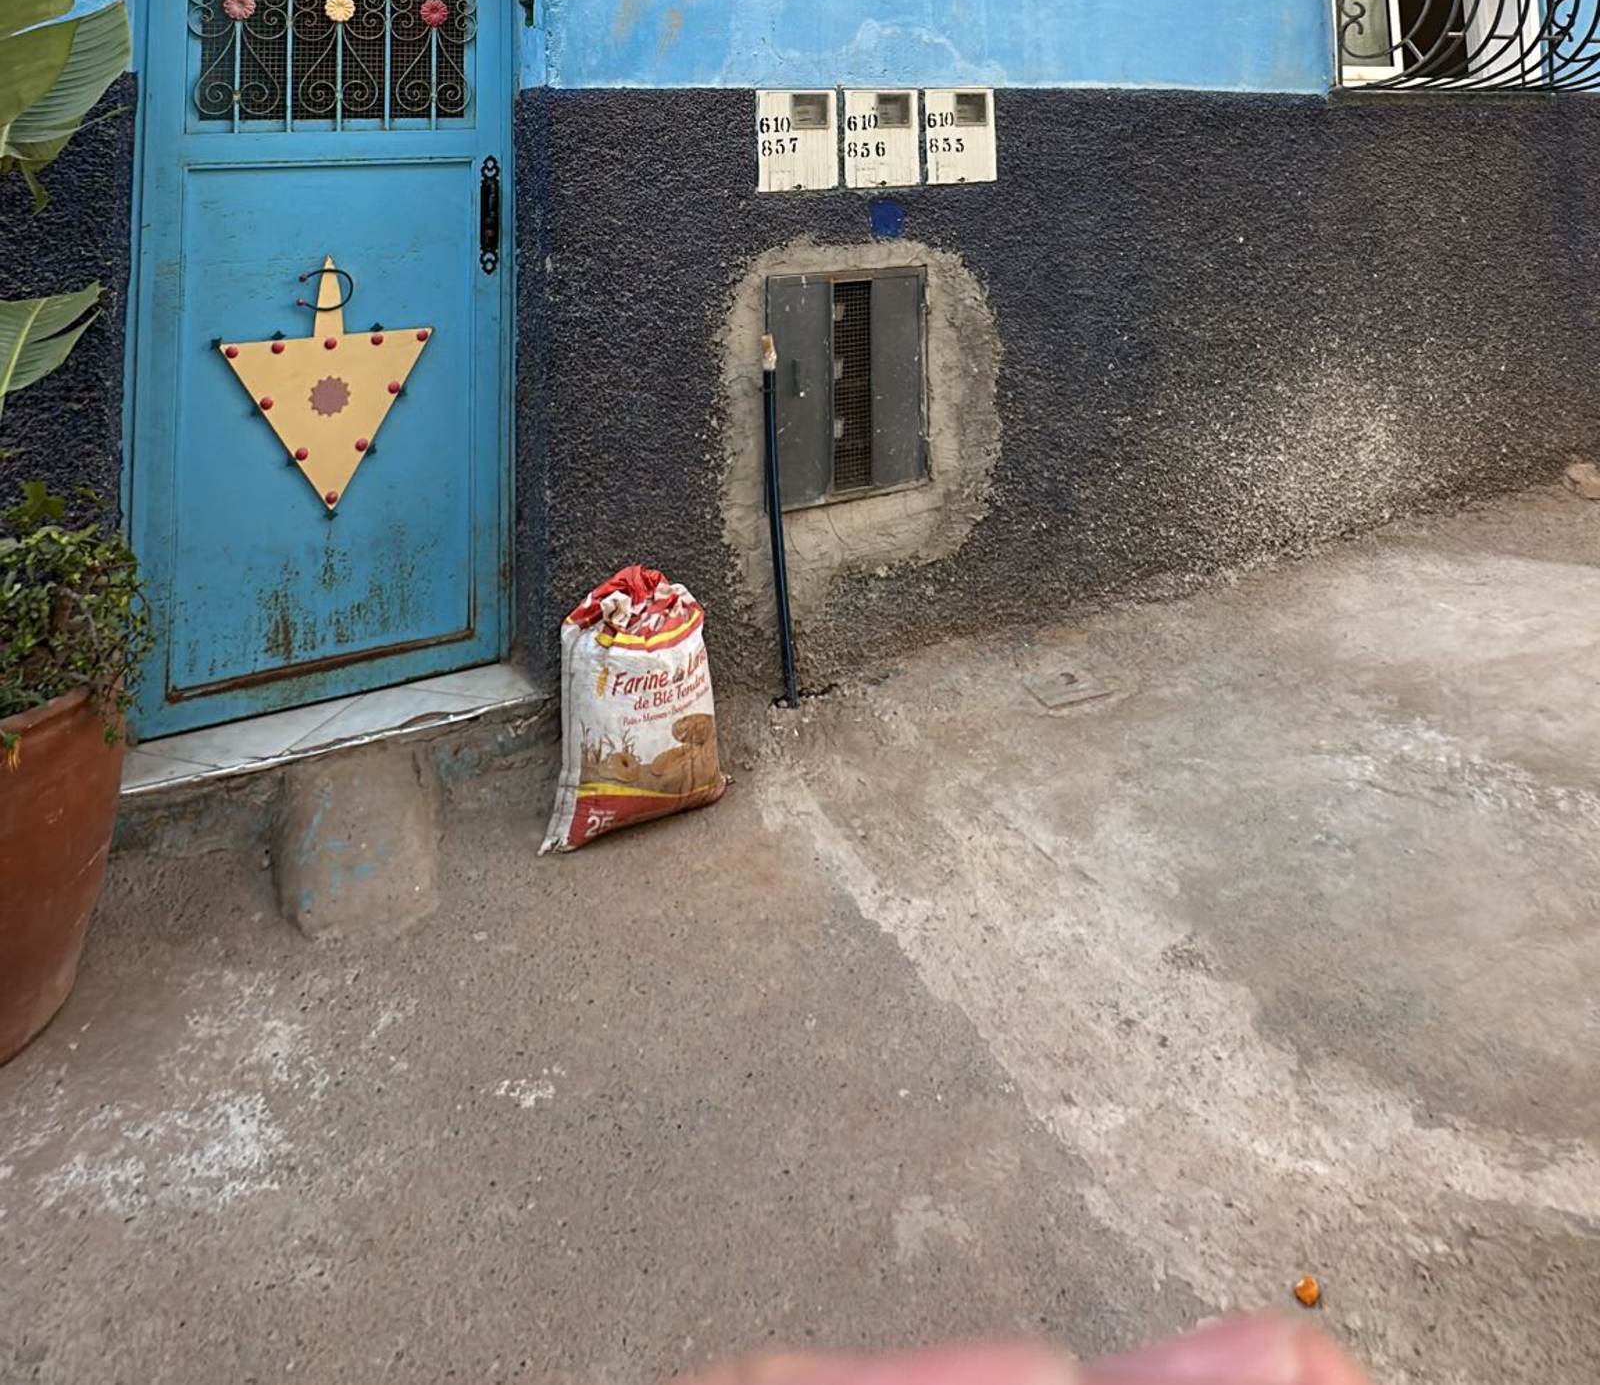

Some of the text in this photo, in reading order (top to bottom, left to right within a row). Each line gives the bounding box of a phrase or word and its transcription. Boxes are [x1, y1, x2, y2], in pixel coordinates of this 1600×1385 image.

[759, 116, 791, 134] 610
[846, 113, 878, 132] 610
[927, 111, 954, 129] 610
[761, 137, 798, 157] 857
[847, 140, 886, 158] 856
[928, 137, 965, 154] 855
[612, 670, 669, 696] Farine
[634, 696, 649, 711] de
[653, 690, 673, 707] Blé
[585, 815, 615, 837] 25
